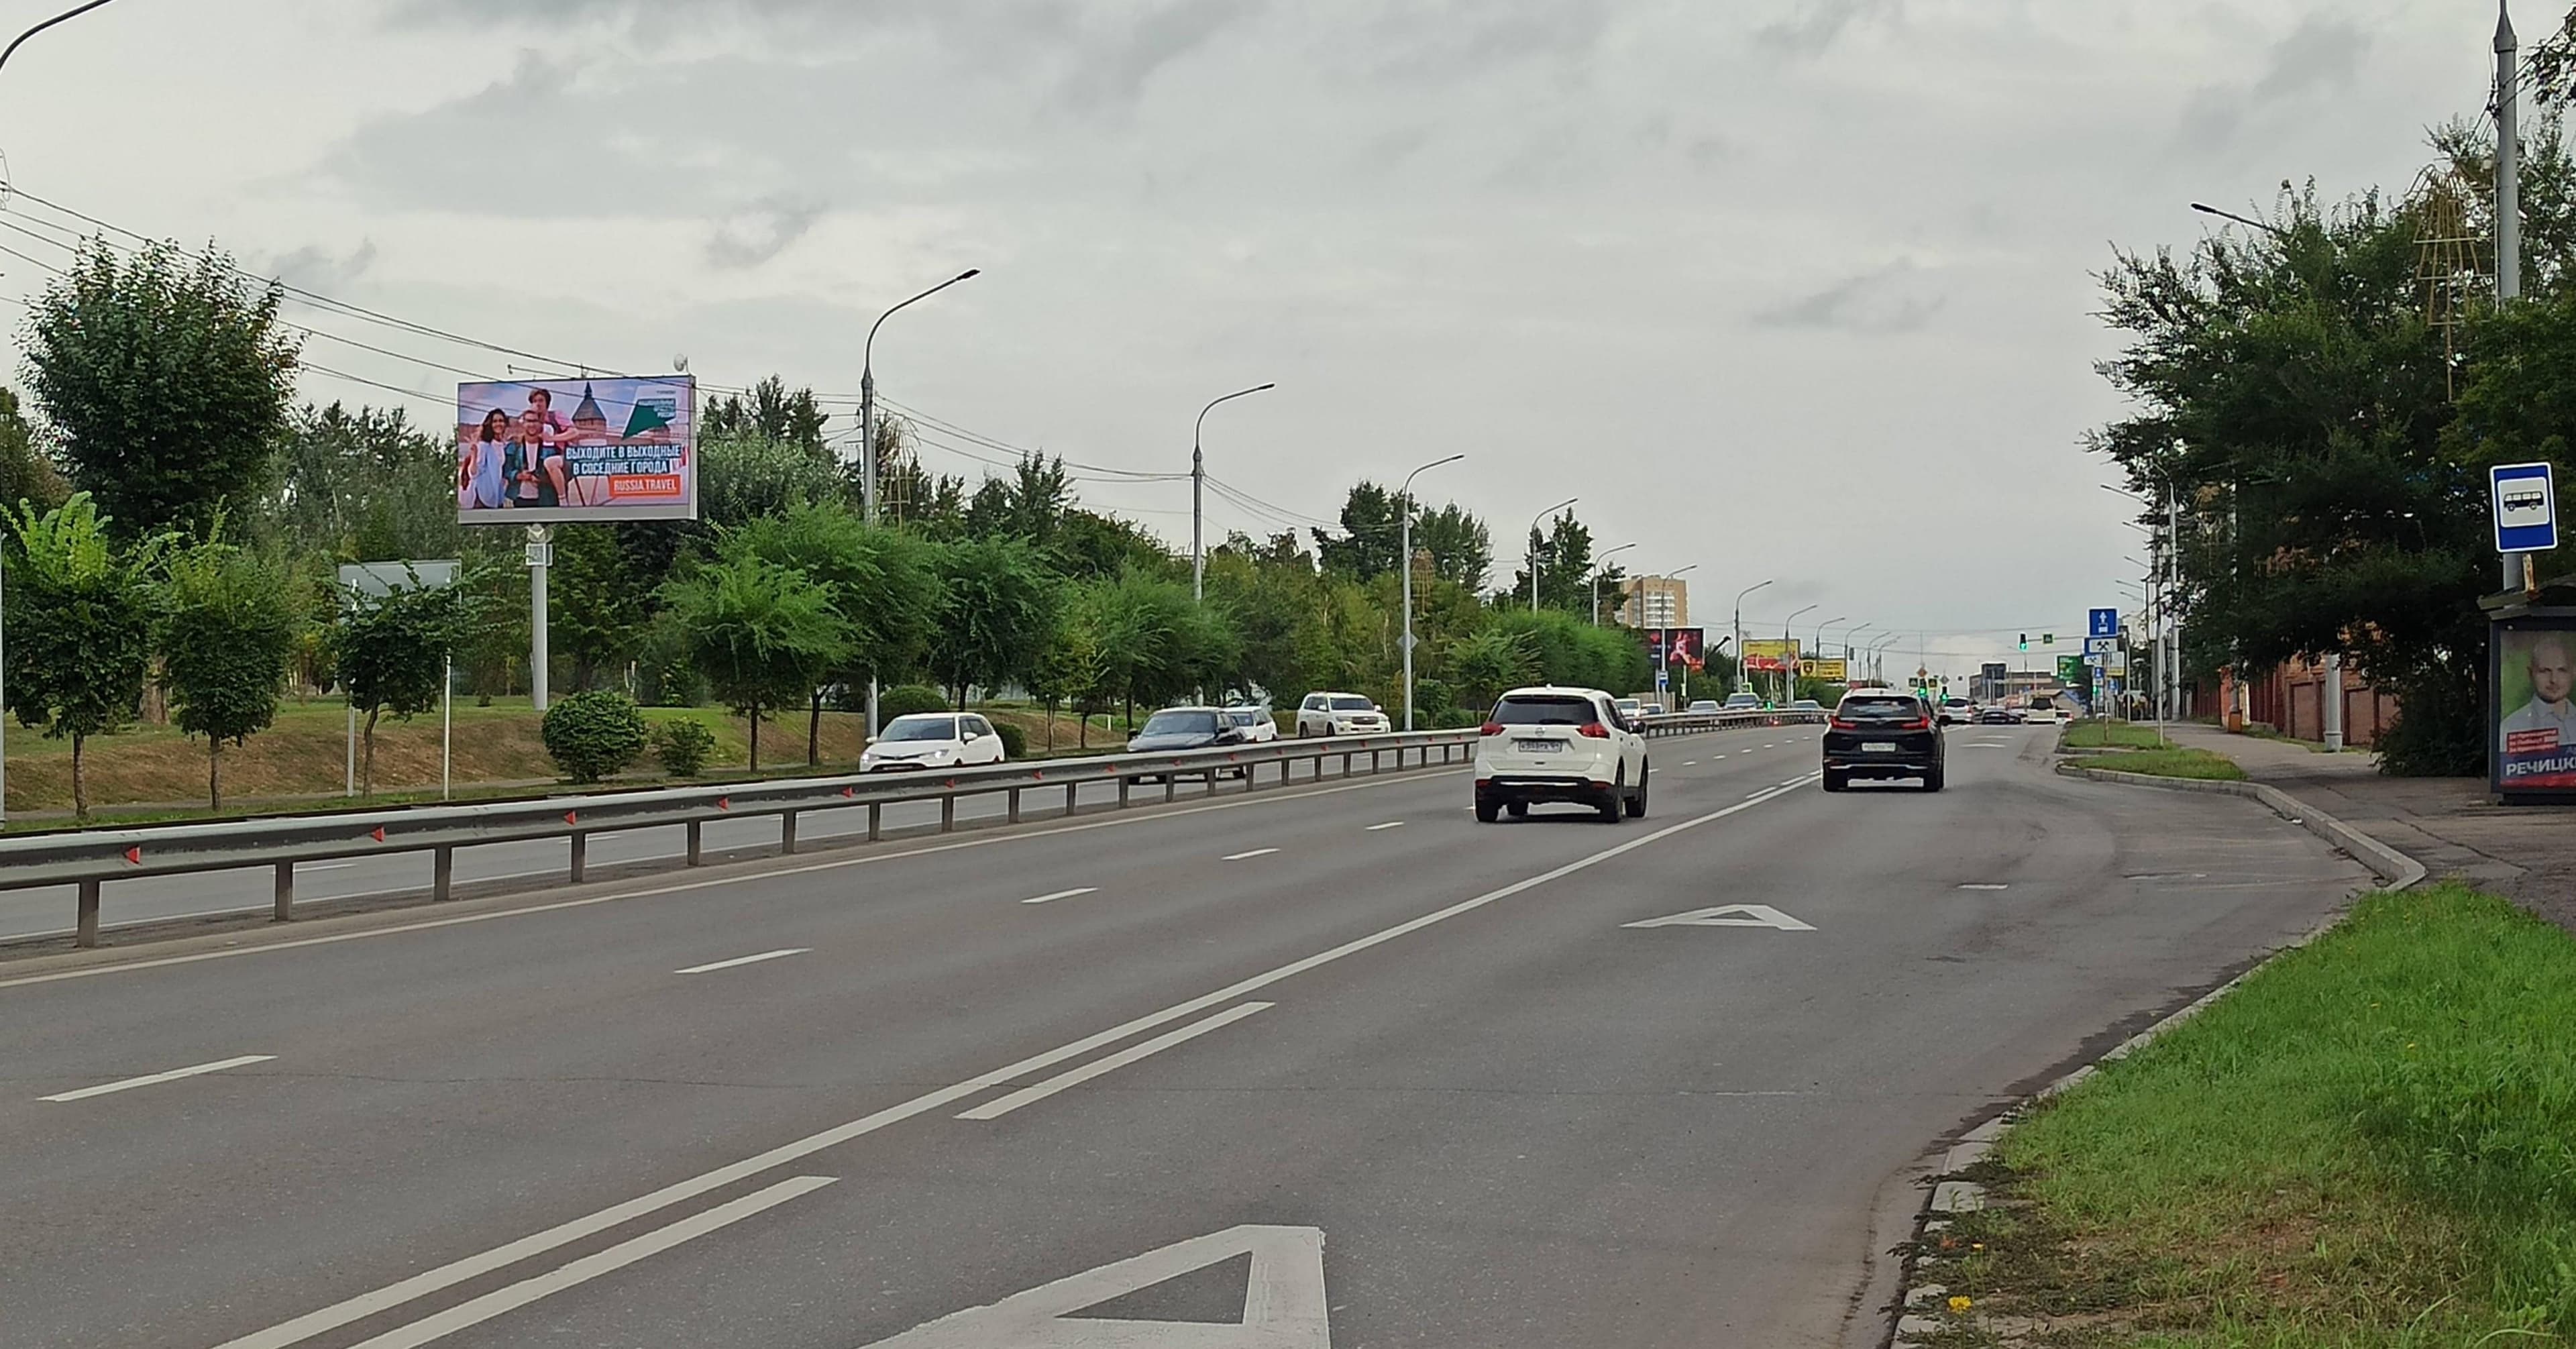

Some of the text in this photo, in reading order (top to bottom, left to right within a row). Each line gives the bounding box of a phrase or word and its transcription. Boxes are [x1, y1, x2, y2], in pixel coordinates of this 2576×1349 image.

[566, 445, 680, 460] ВЫХОДИТЕ В ВЫХОДНЫЕ
[573, 460, 667, 475] В СОСЕДНИЕ ГОРОДА
